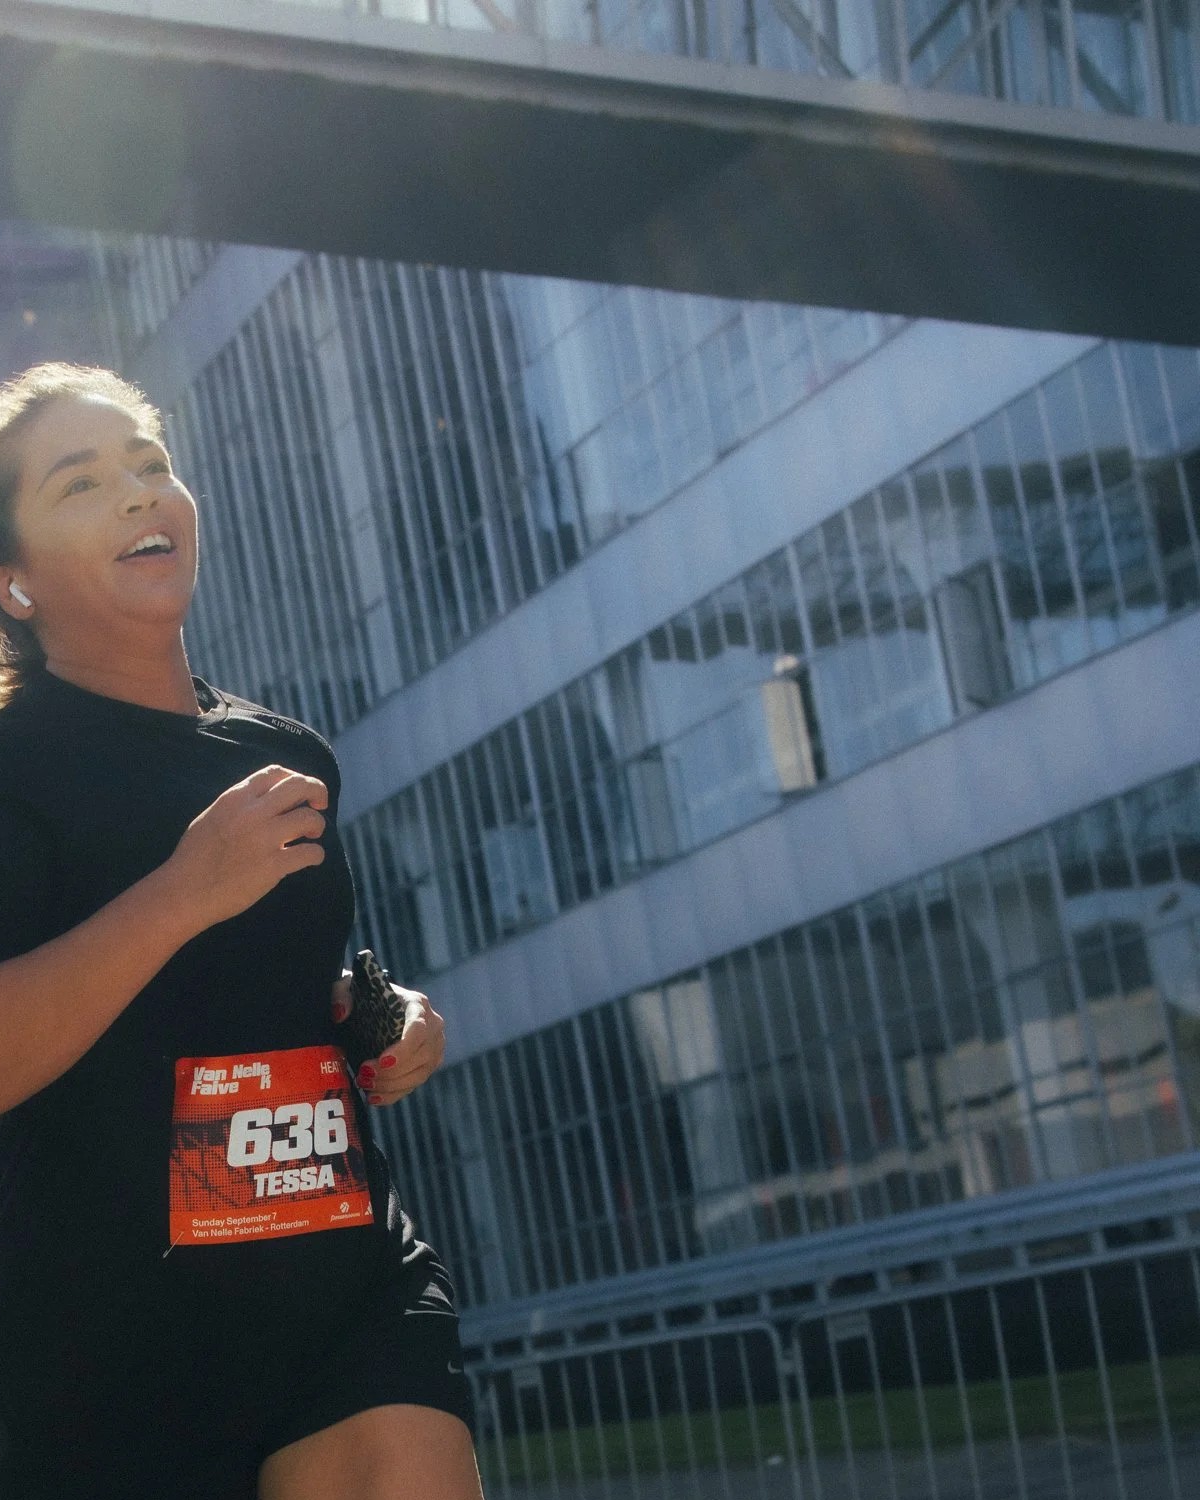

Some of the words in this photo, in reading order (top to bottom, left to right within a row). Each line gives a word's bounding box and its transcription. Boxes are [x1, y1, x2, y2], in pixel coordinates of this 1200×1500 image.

[271, 718, 303, 736] KIPRUN
[193, 1066, 227, 1081] Van
[231, 1062, 271, 1079] Nelle
[260, 1074, 272, 1090] K
[226, 1098, 349, 1168] 636
[253, 1164, 336, 1198] TESSA
[192, 1218, 225, 1228] Sunday
[226, 1214, 272, 1226] September
[272, 1212, 277, 1220] 7
[192, 1229, 209, 1238] Van
[210, 1228, 233, 1237] Nelle
[234, 1225, 264, 1235] Fabriek
[270, 1220, 310, 1231] Rotterdam
